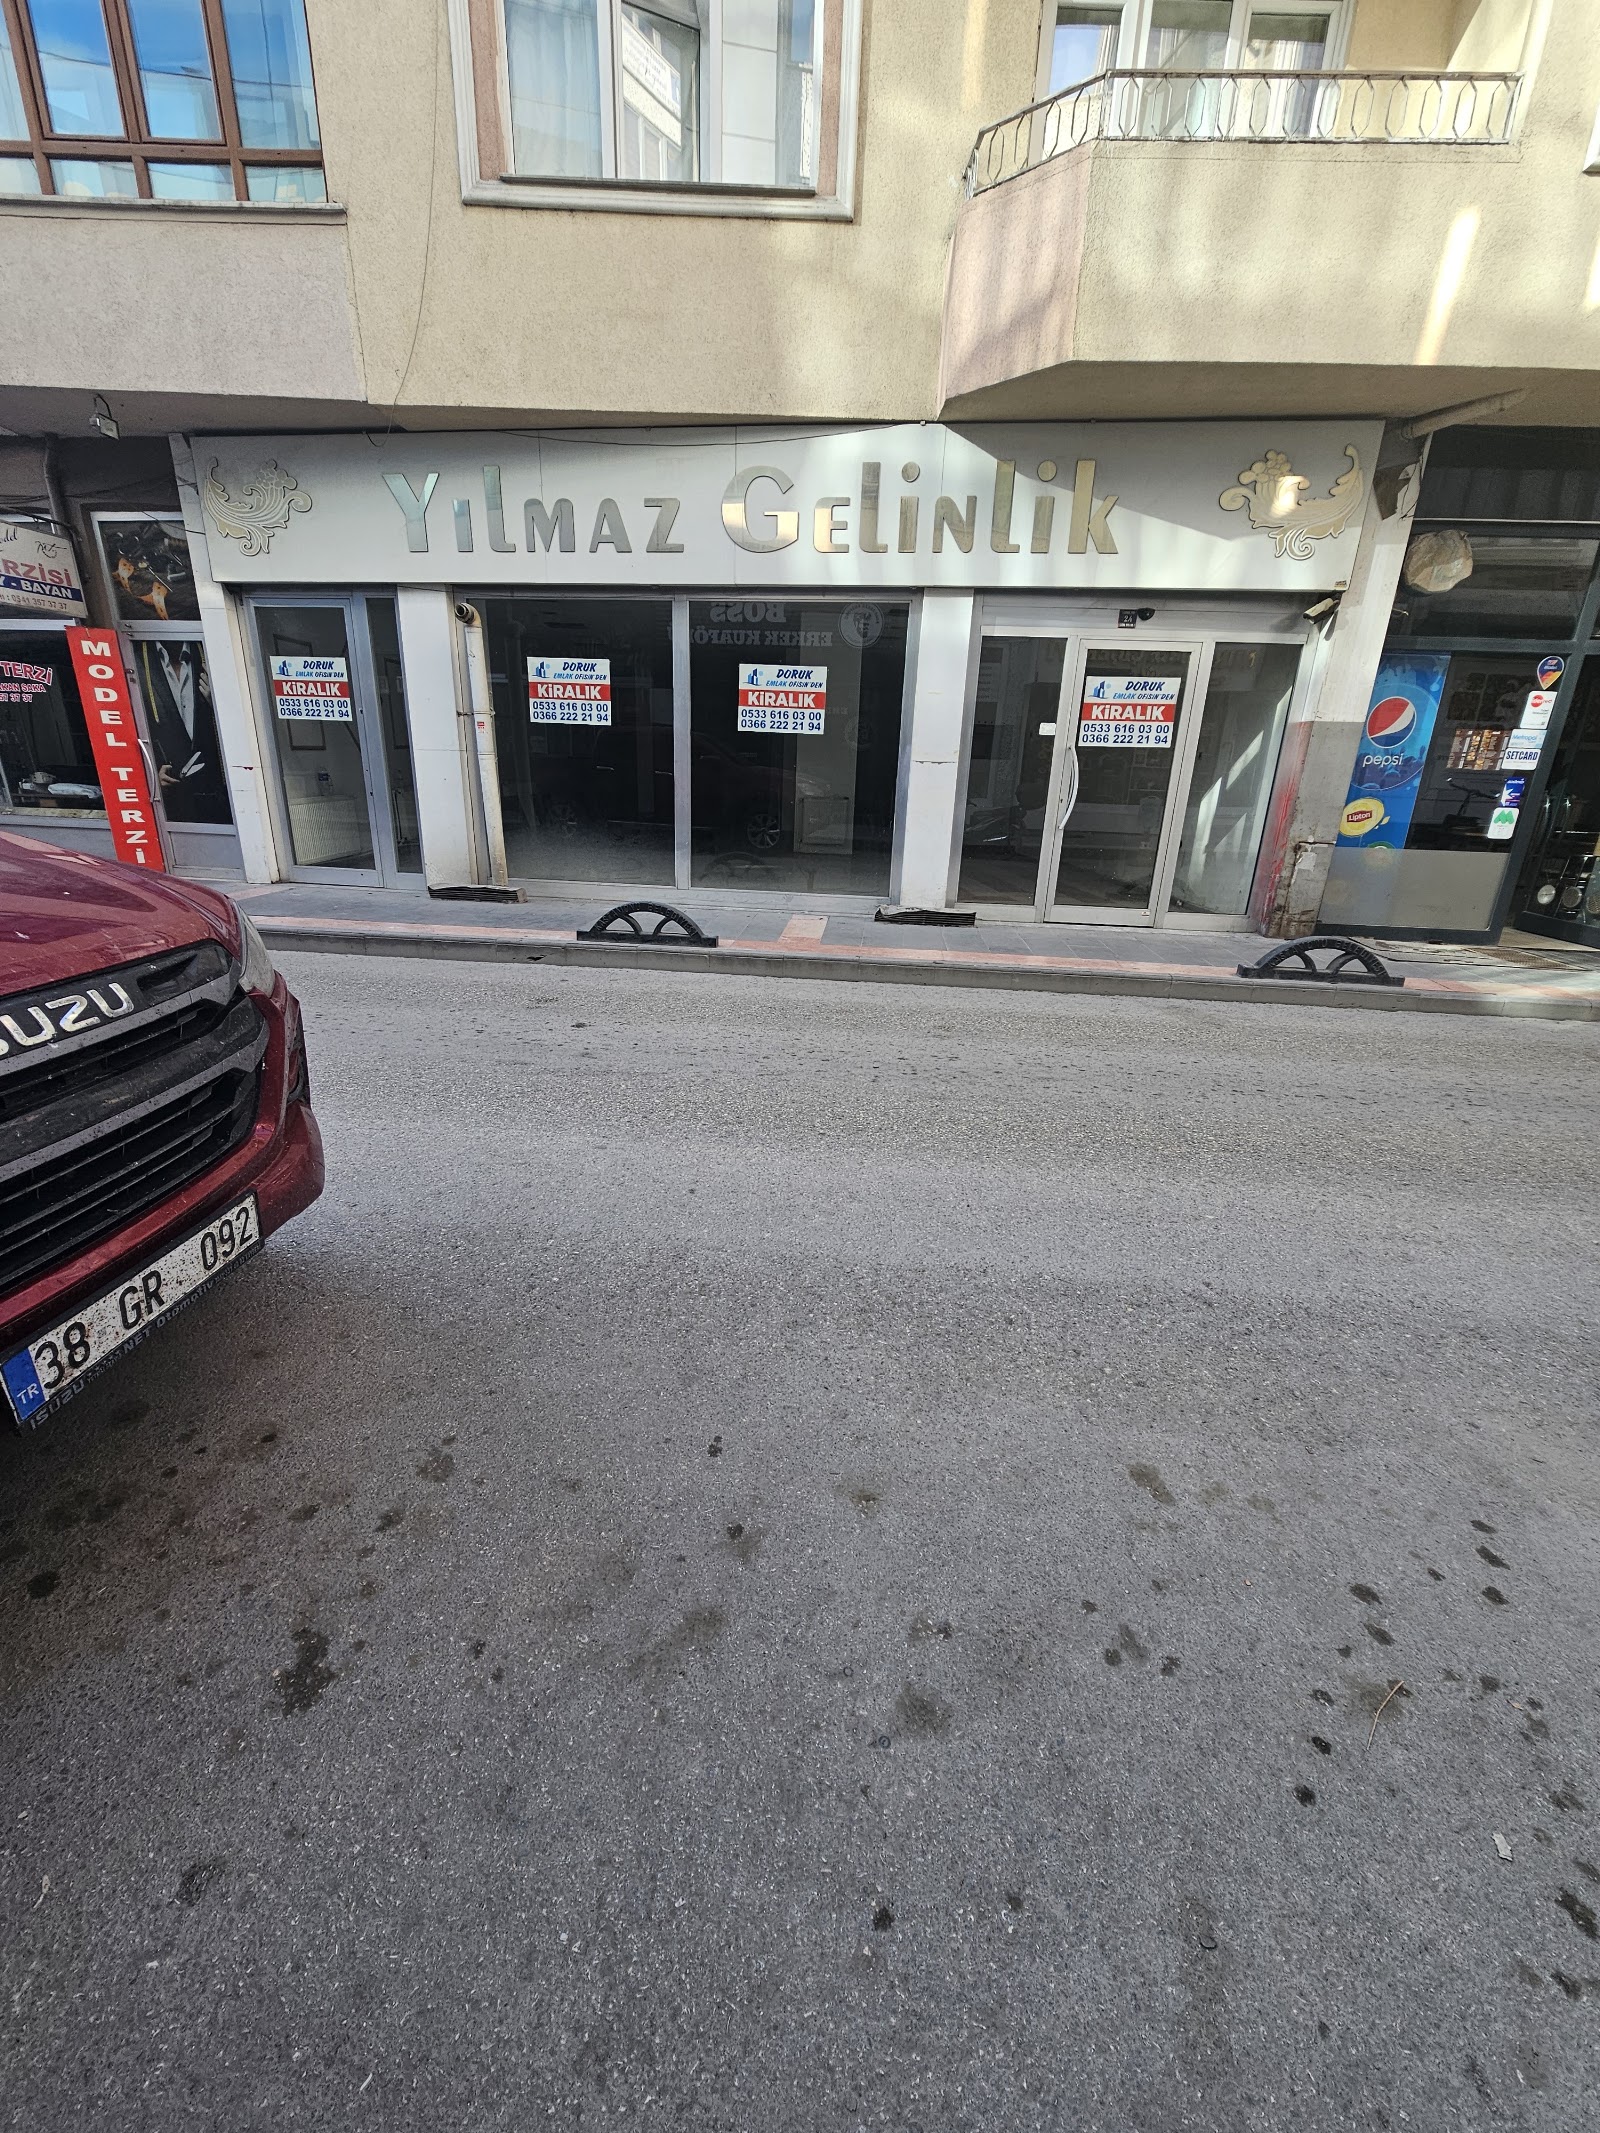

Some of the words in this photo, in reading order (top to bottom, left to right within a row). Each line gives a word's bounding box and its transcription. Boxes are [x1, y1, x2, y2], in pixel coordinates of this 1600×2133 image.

[0, 559, 73, 587] RZİSİ
[21, 580, 73, 599] BAYAN
[33, 598, 46, 607] 357
[48, 600, 57, 608] 37
[58, 602, 67, 610] 37
[303, 660, 335, 670] DORUK
[562, 662, 597, 672] DORUK
[776, 669, 813, 679] DORUK
[0, 683, 20, 692] KAN
[21, 683, 47, 692] SAKA
[1125, 681, 1165, 691] DORUK
[280, 698, 301, 707] 0533
[304, 699, 321, 708] 616
[323, 700, 335, 708] 03
[337, 700, 348, 708] 00
[533, 701, 557, 710] 0533
[560, 702, 578, 711] 616
[581, 703, 593, 712] 03
[596, 704, 608, 712] 00
[280, 708, 302, 716] 0366
[305, 709, 321, 717] 222
[325, 709, 335, 717] 21
[533, 711, 557, 720] 0366
[560, 712, 578, 721] 222
[581, 713, 592, 721] 21
[597, 713, 608, 722] 94
[741, 709, 767, 718] 0533
[770, 710, 789, 719] 616
[792, 711, 805, 720] 03
[808, 712, 821, 721] 00
[741, 719, 766, 728] 0366
[770, 720, 788, 729] 222
[792, 721, 804, 730] 21
[808, 722, 821, 731] 94
[1083, 724, 1110, 732] 0533
[1114, 724, 1135, 733] 616
[1138, 725, 1152, 733] 03
[1156, 725, 1169, 733] 00
[1082, 734, 1109, 743] 0366
[1113, 735, 1133, 743] 222
[1137, 735, 1149, 744] 21
[1154, 735, 1168, 744] 94
[81, 640, 127, 747] MODEL
[111, 767, 148, 864] TERZİ
[1506, 751, 1538, 760] SETCARD
[1362, 753, 1404, 767] pepsi
[1348, 812, 1371, 821] Lipton
[0, 983, 134, 1056] UZU
[35, 1321, 91, 1390] 38
[118, 1269, 165, 1331] GR
[200, 1206, 253, 1271] 092
[30, 1380, 85, 1431] ISUZU
[124, 1330, 151, 1354] NET
[17, 1383, 40, 1404] TR
